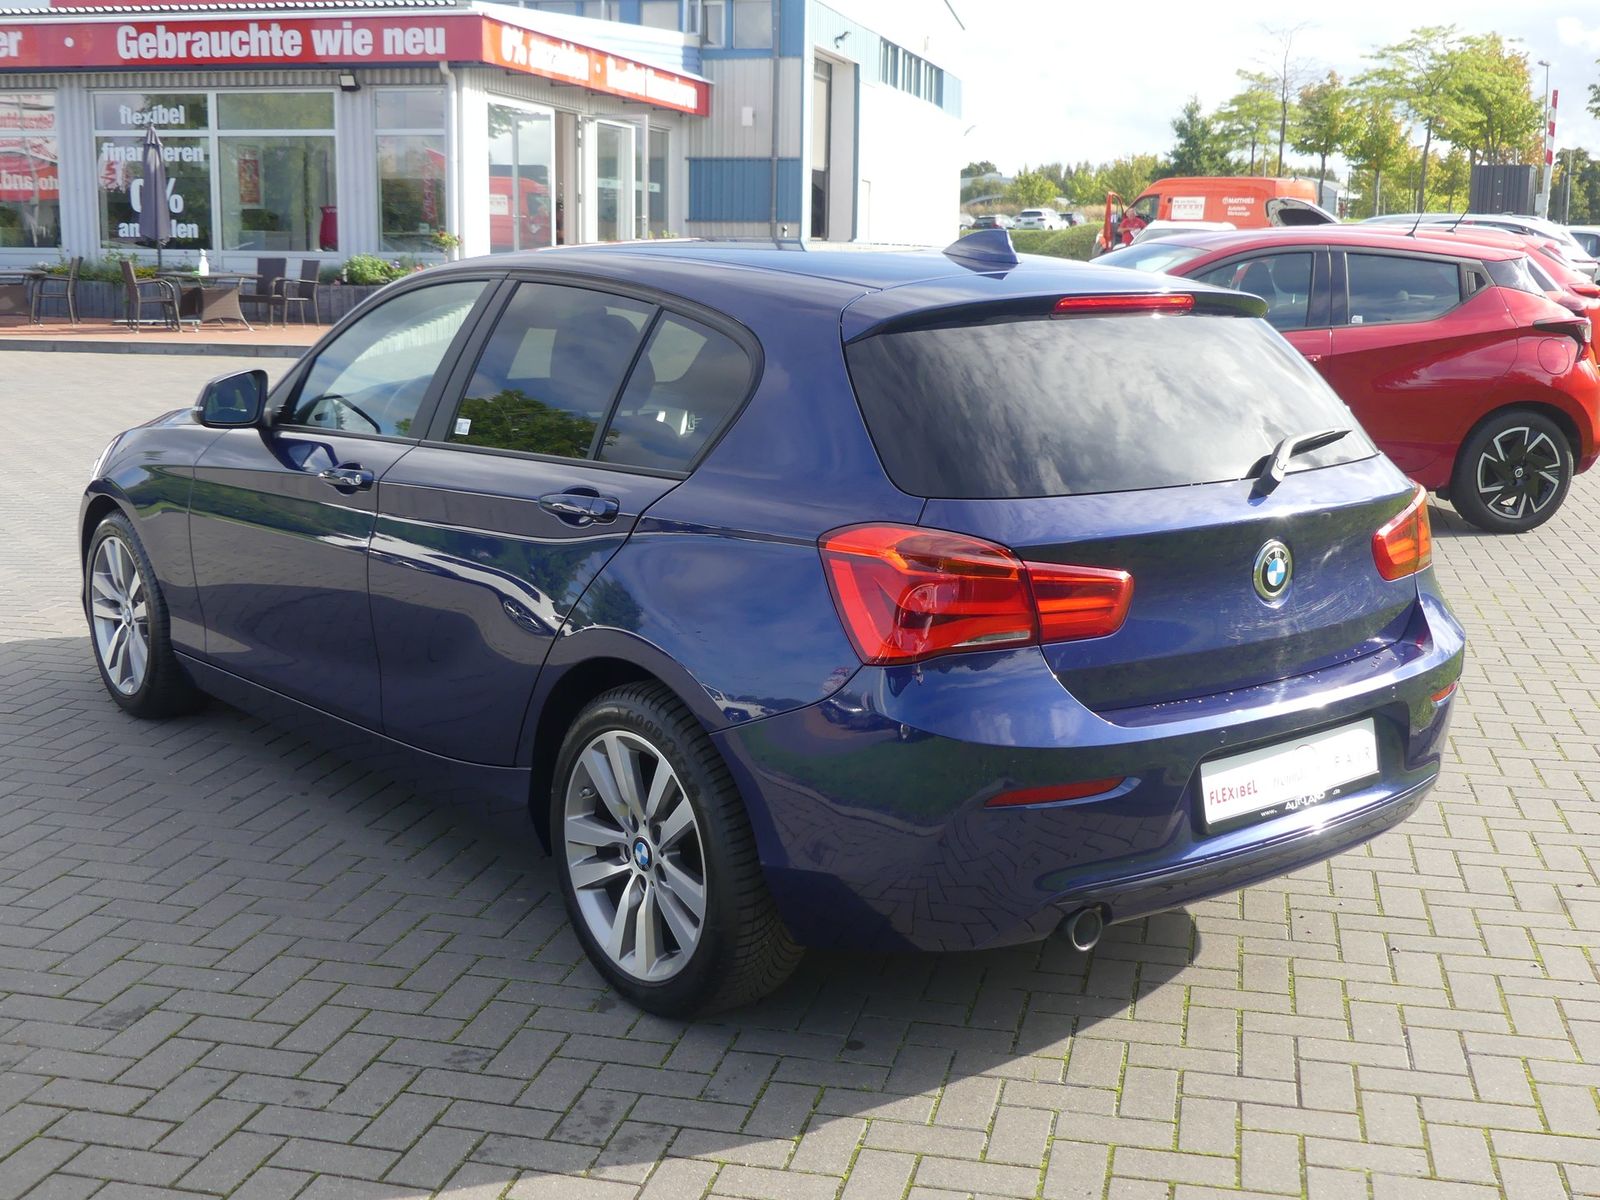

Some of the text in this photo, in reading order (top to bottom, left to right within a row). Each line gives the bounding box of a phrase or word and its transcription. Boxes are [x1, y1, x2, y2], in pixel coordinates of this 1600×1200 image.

[117, 21, 446, 60] Gebrauchte wie neu
[119, 104, 185, 125] flexibel
